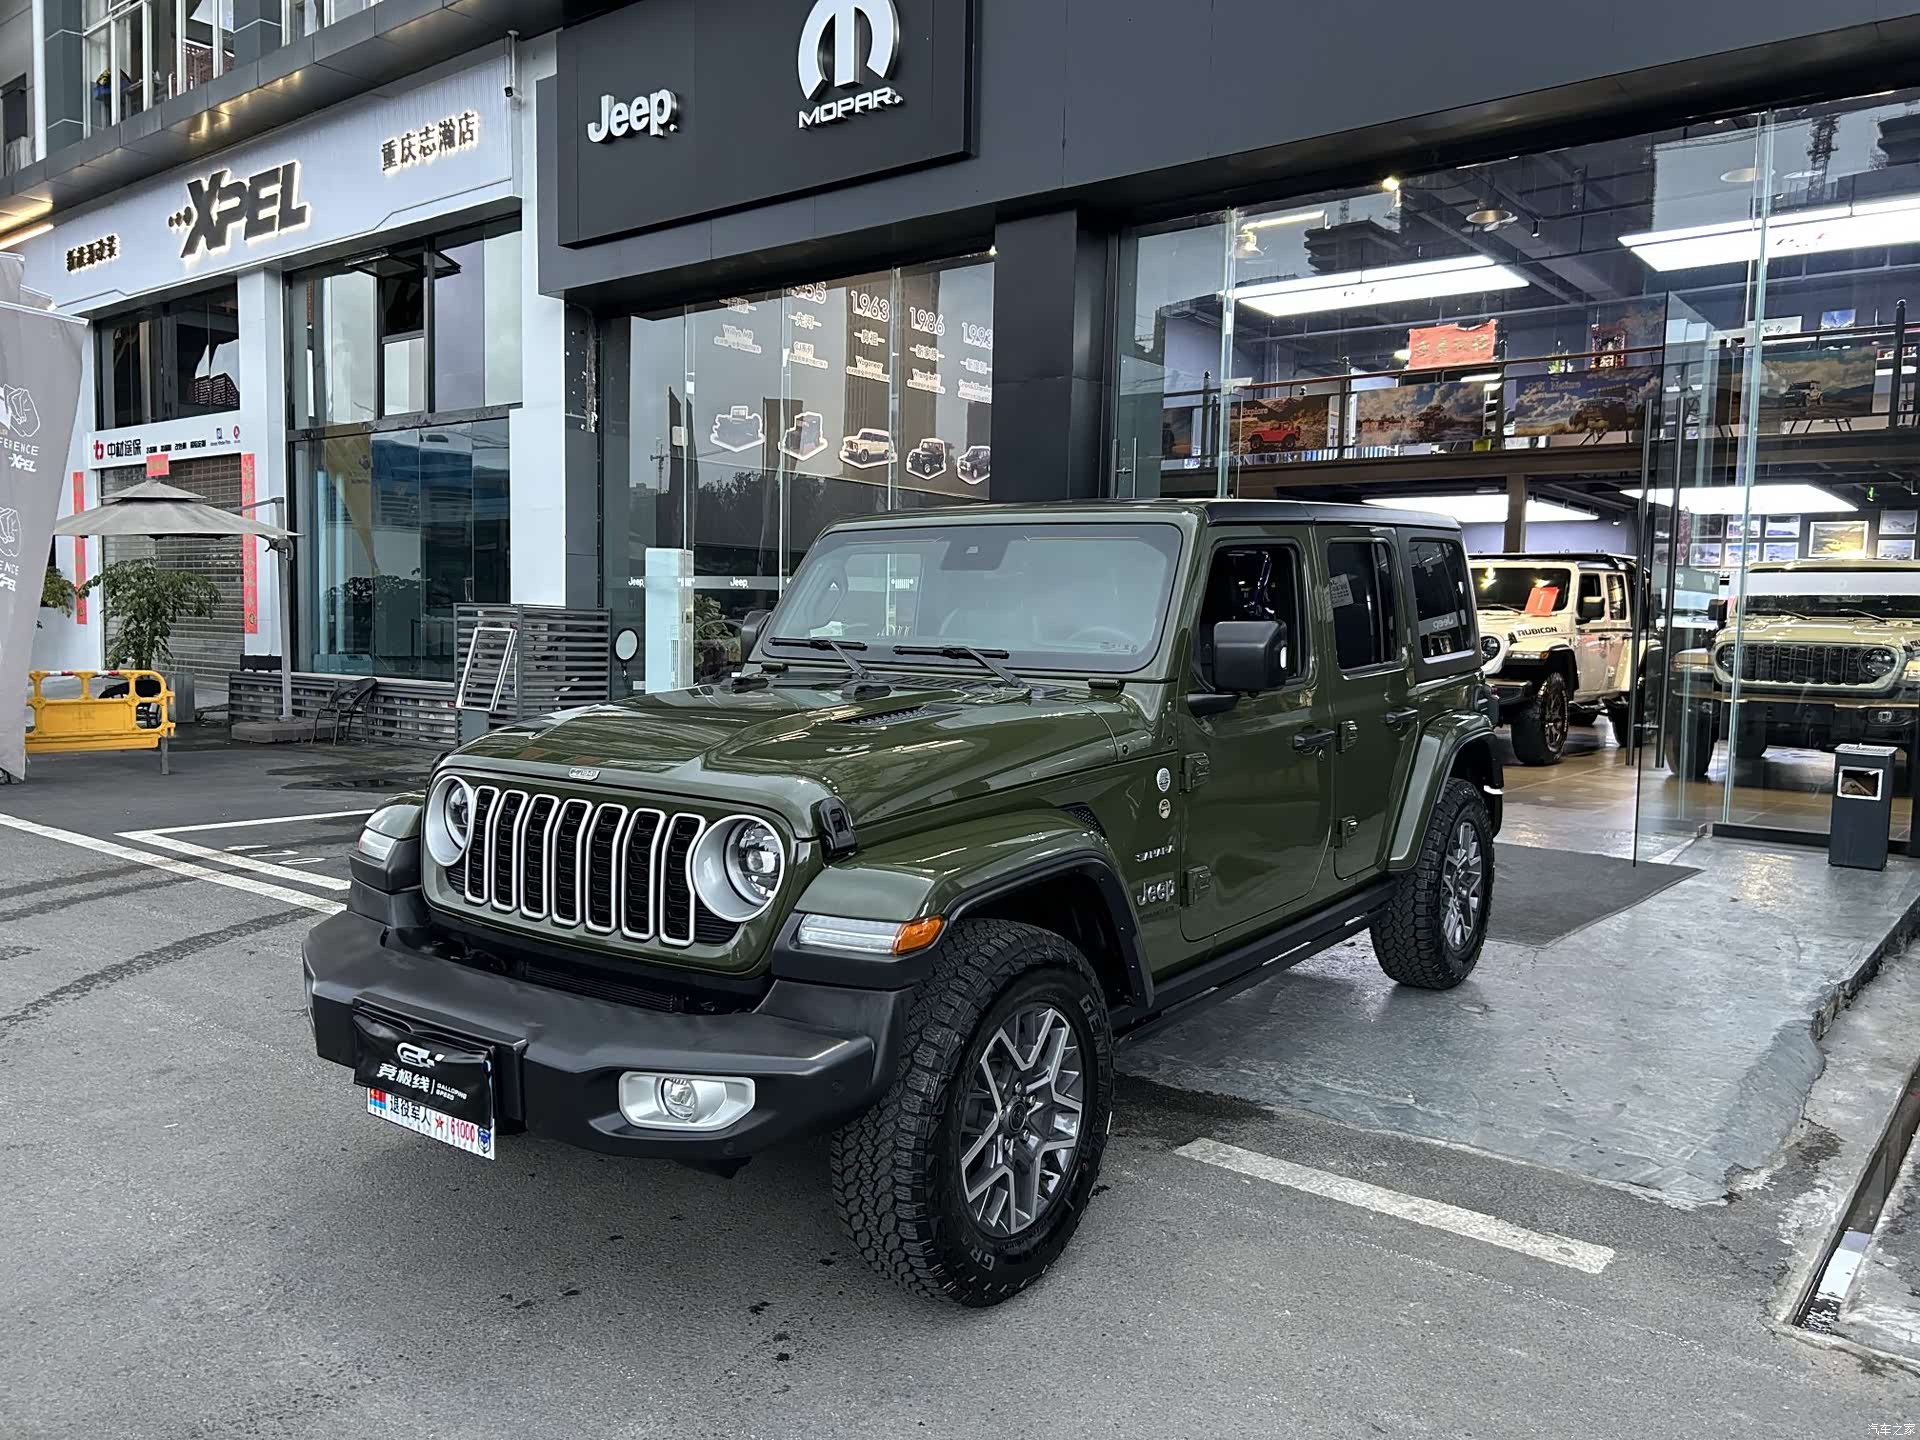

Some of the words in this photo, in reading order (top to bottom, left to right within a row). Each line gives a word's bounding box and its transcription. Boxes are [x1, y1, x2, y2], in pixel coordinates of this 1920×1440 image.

[382, 112, 477, 172] 重庆志瀚店
[180, 161, 308, 259] XPEL
[851, 290, 889, 322] 1963
[909, 306, 945, 336] 1986
[730, 577, 748, 588] Jeep
[1516, 626, 1558, 636] RUBICON
[1136, 879, 1176, 906] Jeep
[435, 1089, 455, 1101] SPEED
[436, 1082, 468, 1101] GALLOPING
